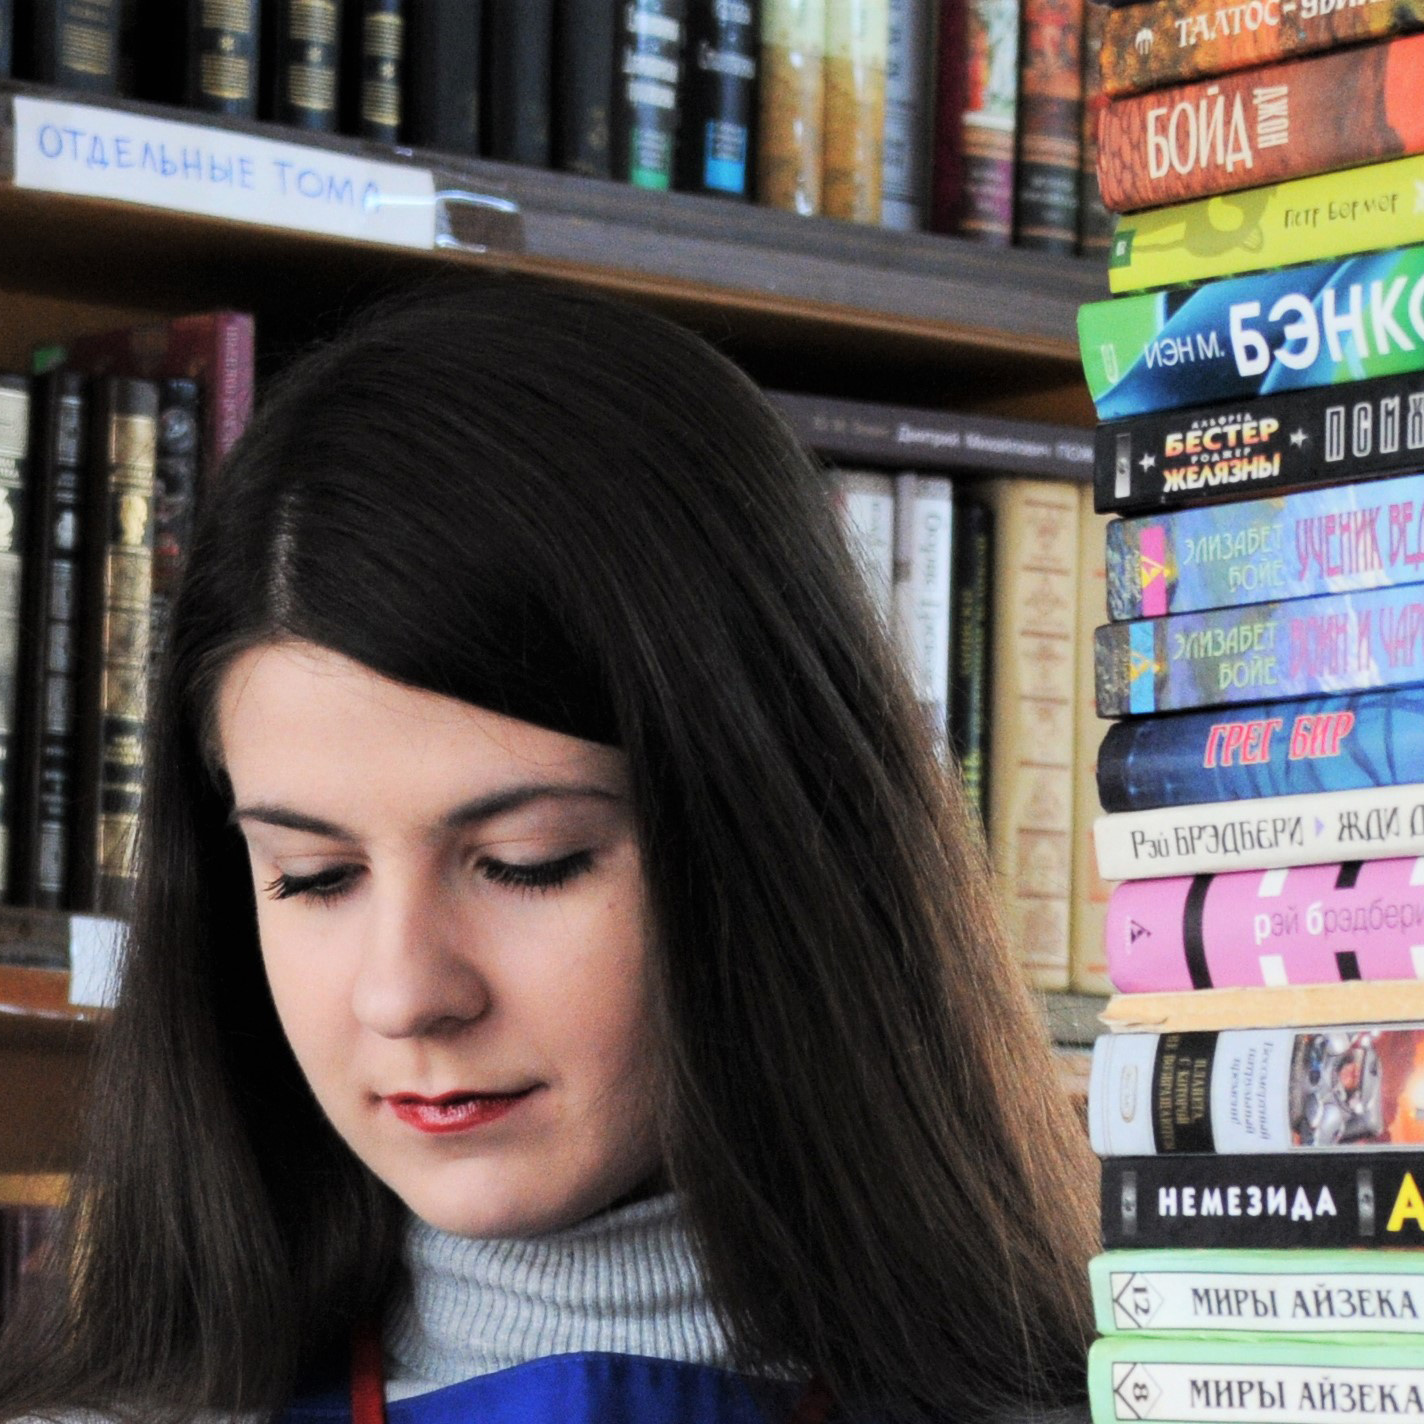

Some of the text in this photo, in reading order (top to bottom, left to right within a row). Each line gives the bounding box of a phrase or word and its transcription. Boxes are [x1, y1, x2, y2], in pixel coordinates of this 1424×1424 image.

[1147, 86, 1253, 180] БОЙД
[1253, 85, 1289, 149] ДЖОН
[37, 123, 256, 189] ОТДЕЛЬНЫЕ
[1143, 333, 1194, 370] ИЭН
[1164, 419, 1280, 459] БЕСТЕР
[1162, 452, 1282, 494] ЖЕЛЯЗНЫ
[1183, 524, 1284, 567] ЭЛИЗАБЕТ
[1295, 502, 1381, 582] УЧЕНИК
[1173, 621, 1279, 661] ЭЛИЗАБЕТ
[1205, 710, 1356, 771] ГРЕГ БИР
[1174, 815, 1306, 858] БРЭДБЕРИ
[1337, 803, 1403, 843] ЖДИ
[1254, 910, 1301, 948] рэй
[1157, 1184, 1338, 1222] НЕМЕЗИДА
[1191, 1286, 1279, 1319] МИРЫ
[1292, 1283, 1419, 1321] АЙЗЕКА
[1189, 1376, 1286, 1411] МИРЫ
